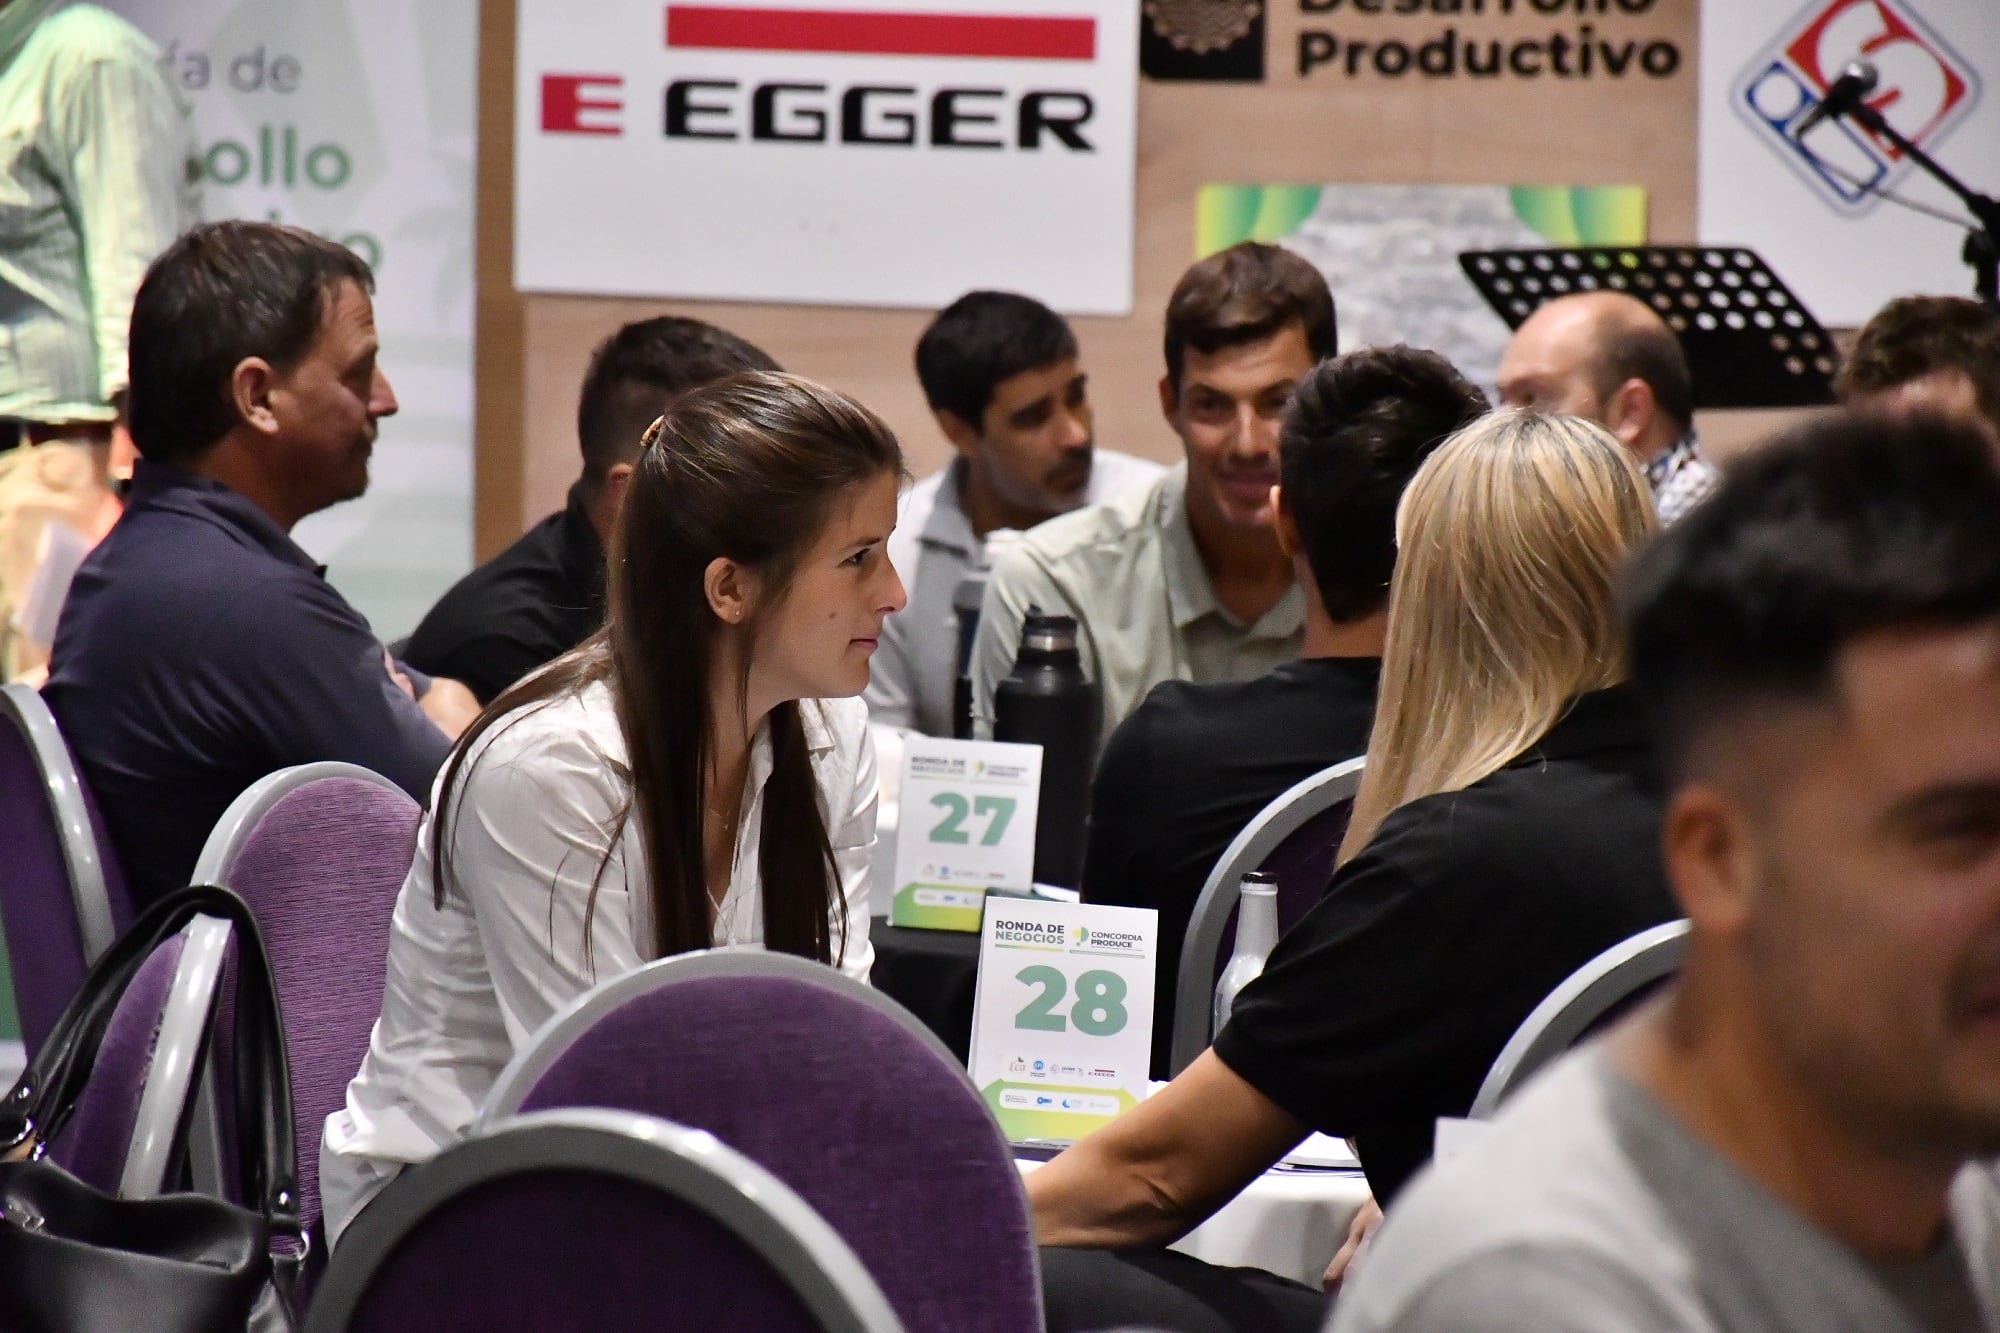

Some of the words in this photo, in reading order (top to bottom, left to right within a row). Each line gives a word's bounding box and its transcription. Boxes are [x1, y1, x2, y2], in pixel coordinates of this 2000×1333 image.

[229, 44, 302, 94] de
[1296, 26, 1682, 78] Productivo
[664, 80, 1096, 152] EGGER
[928, 792, 1017, 846] 27
[995, 920, 1043, 933] RONDA
[1047, 924, 1065, 934] DE
[995, 930, 1065, 945] NEGOCIOS
[1091, 931, 1143, 942] CONCORDIA
[1091, 939, 1132, 948] PRODUCE
[1014, 964, 1128, 1037] 28
